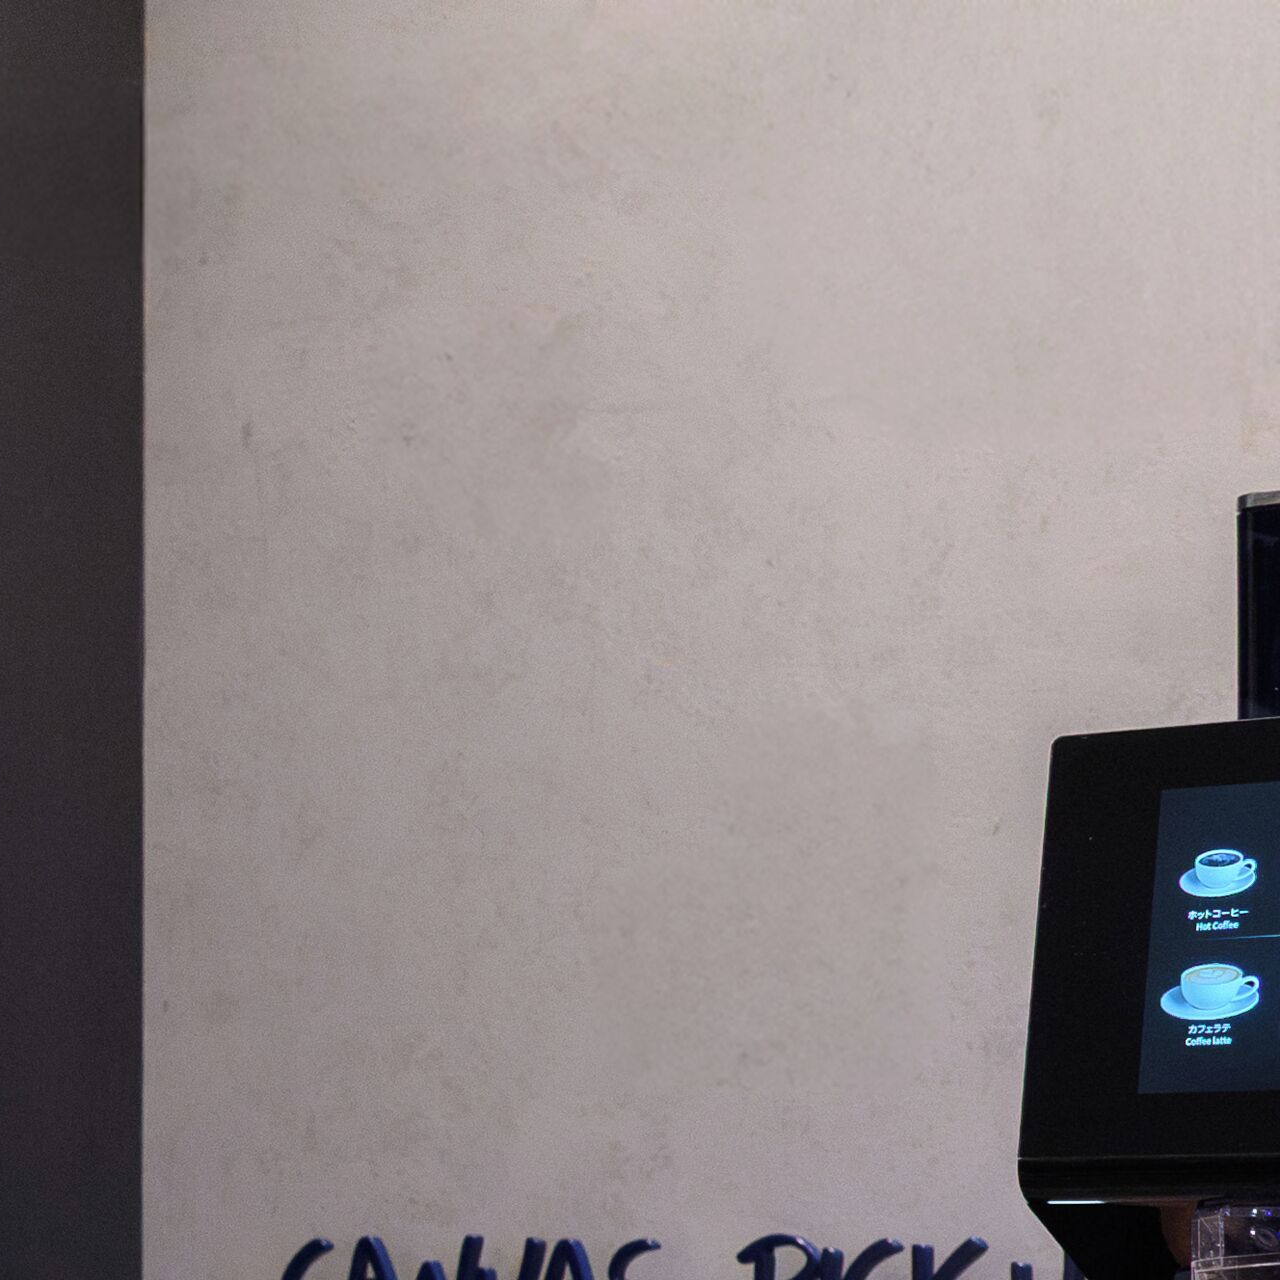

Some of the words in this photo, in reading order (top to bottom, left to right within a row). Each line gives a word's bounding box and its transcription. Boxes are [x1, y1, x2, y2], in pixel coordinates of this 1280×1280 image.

[1187, 908, 1250, 920] ホットコーヒー
[1195, 921, 1212, 931] Hot
[1212, 920, 1240, 931] Coffee
[1187, 1023, 1232, 1034] カフェラテ
[1185, 1036, 1212, 1046] Coffee
[1212, 1035, 1233, 1045] latte
